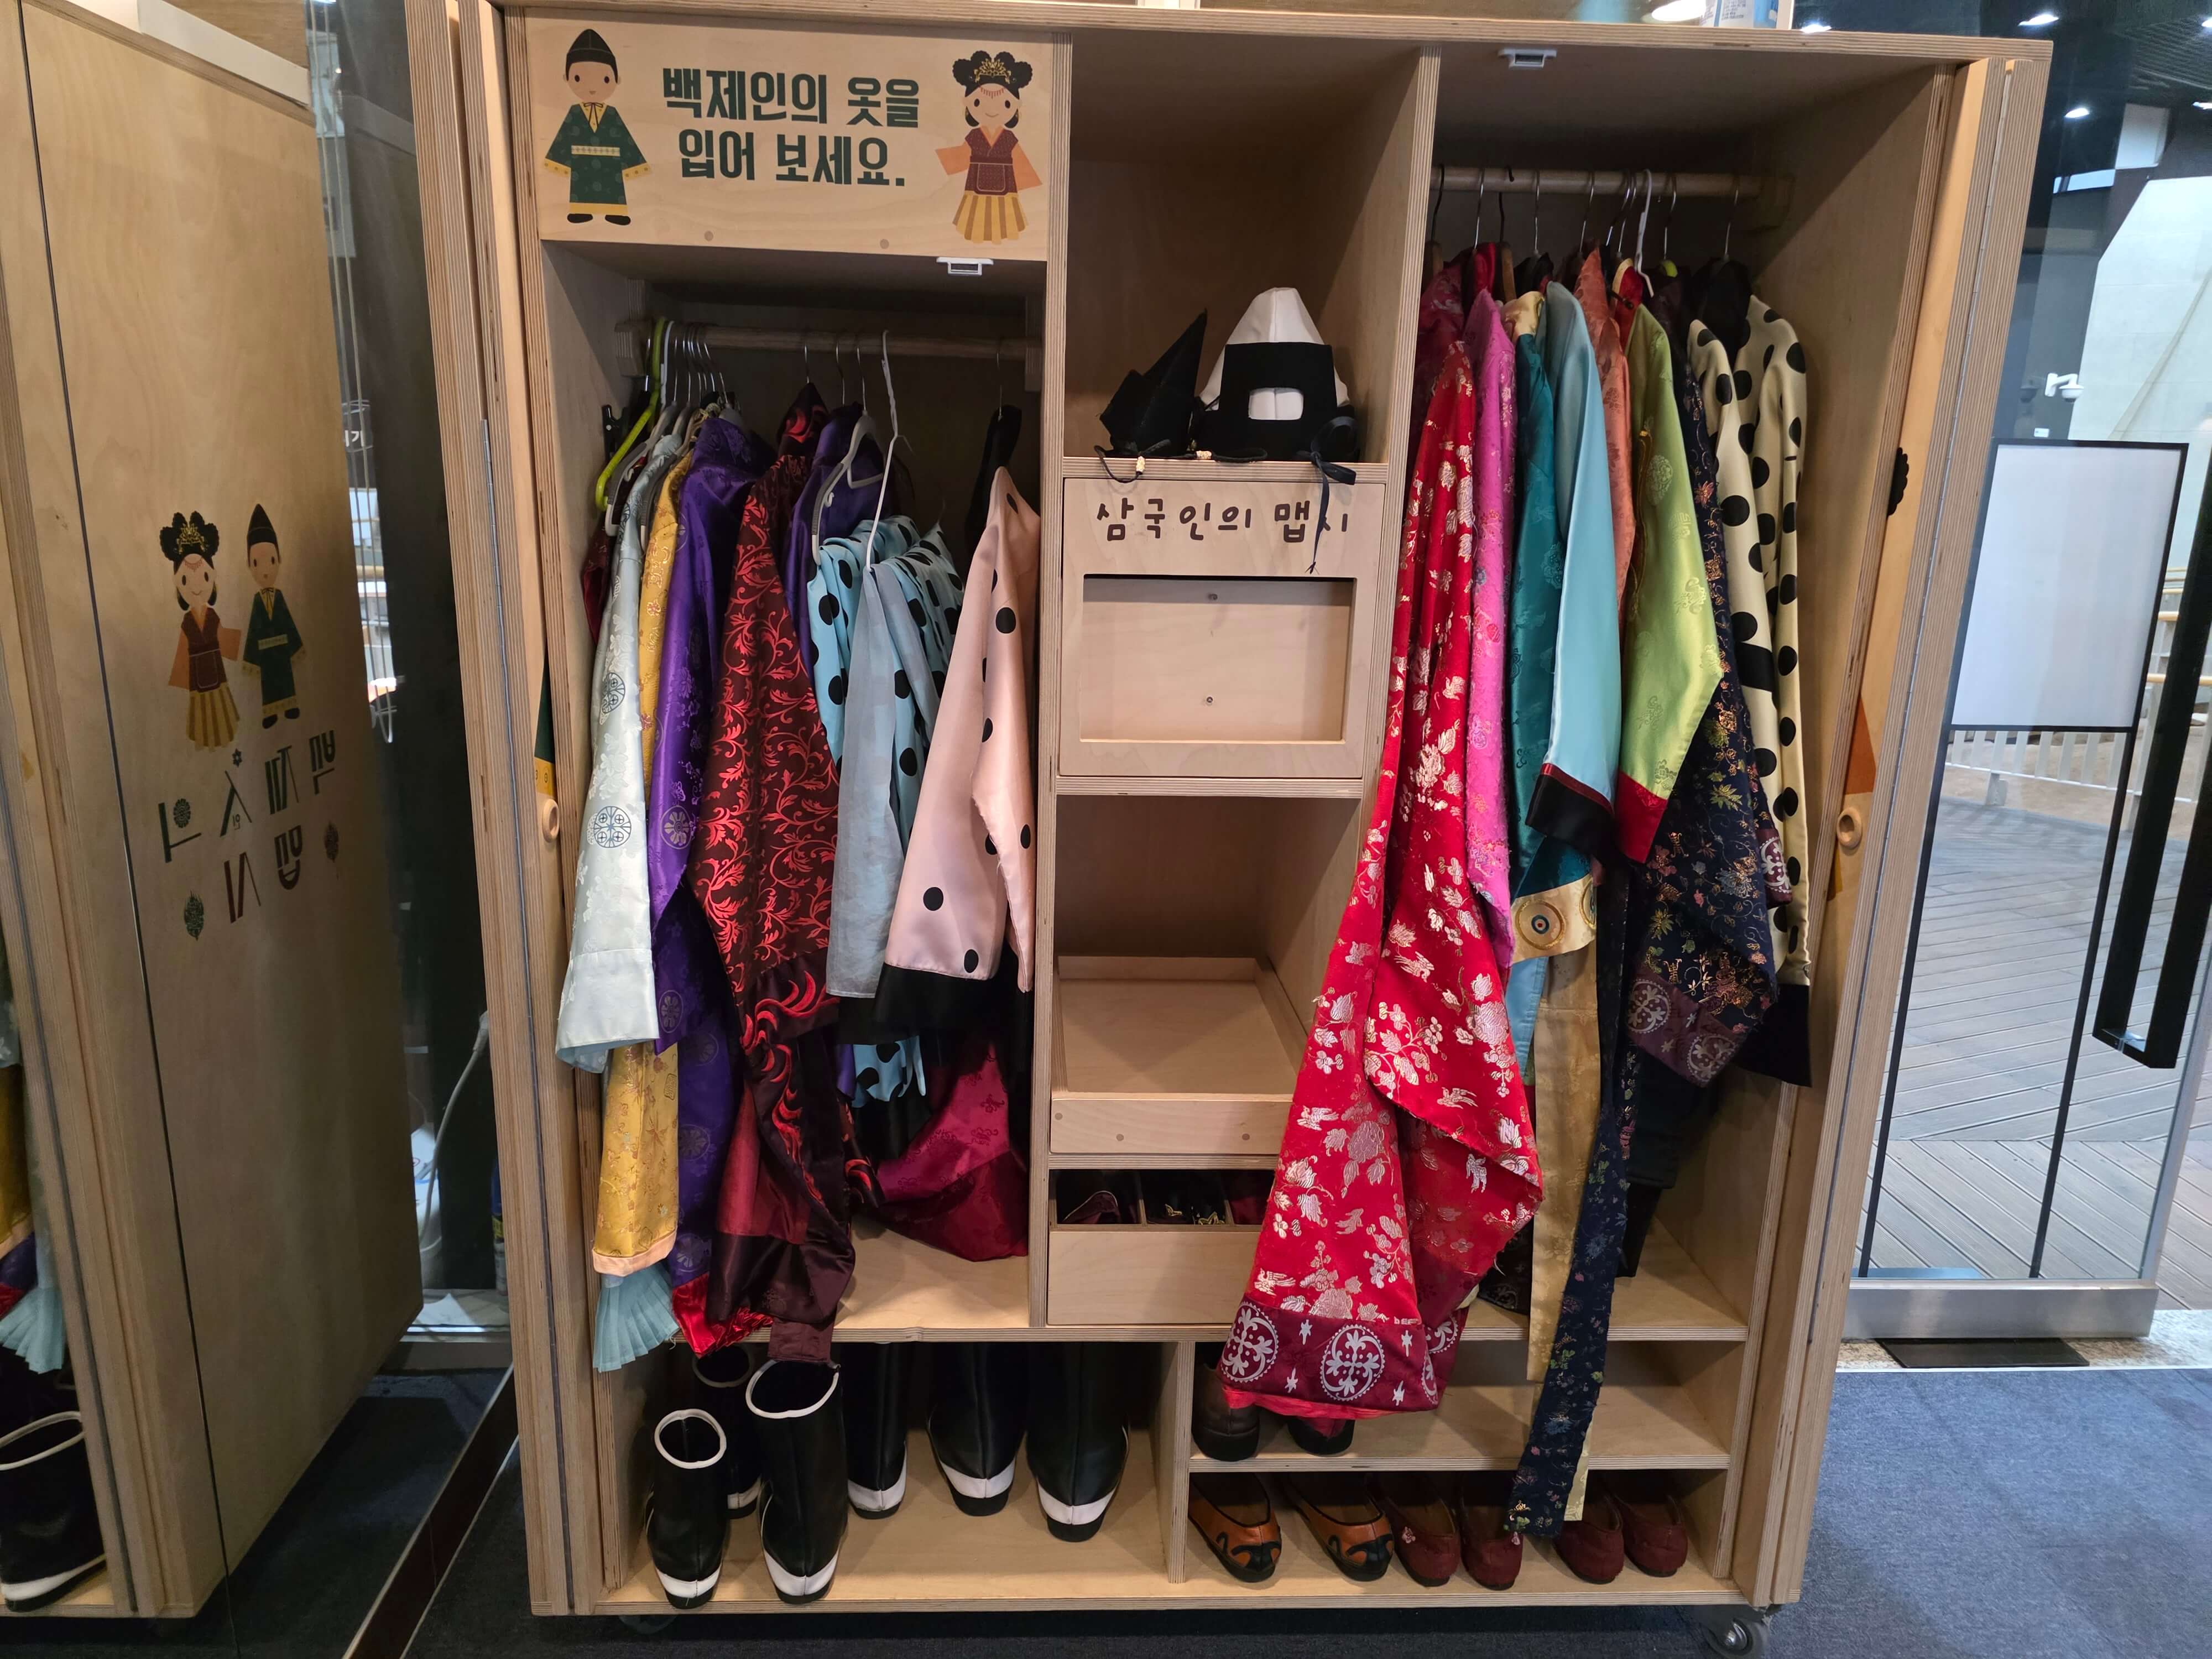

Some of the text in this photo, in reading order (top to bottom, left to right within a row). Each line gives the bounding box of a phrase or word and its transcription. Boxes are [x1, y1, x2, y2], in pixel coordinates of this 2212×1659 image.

[662, 67, 920, 128] 백제인의 옷을
[679, 129, 905, 186] 입어 보세요.
[1097, 498, 1251, 541] 삼국인의
